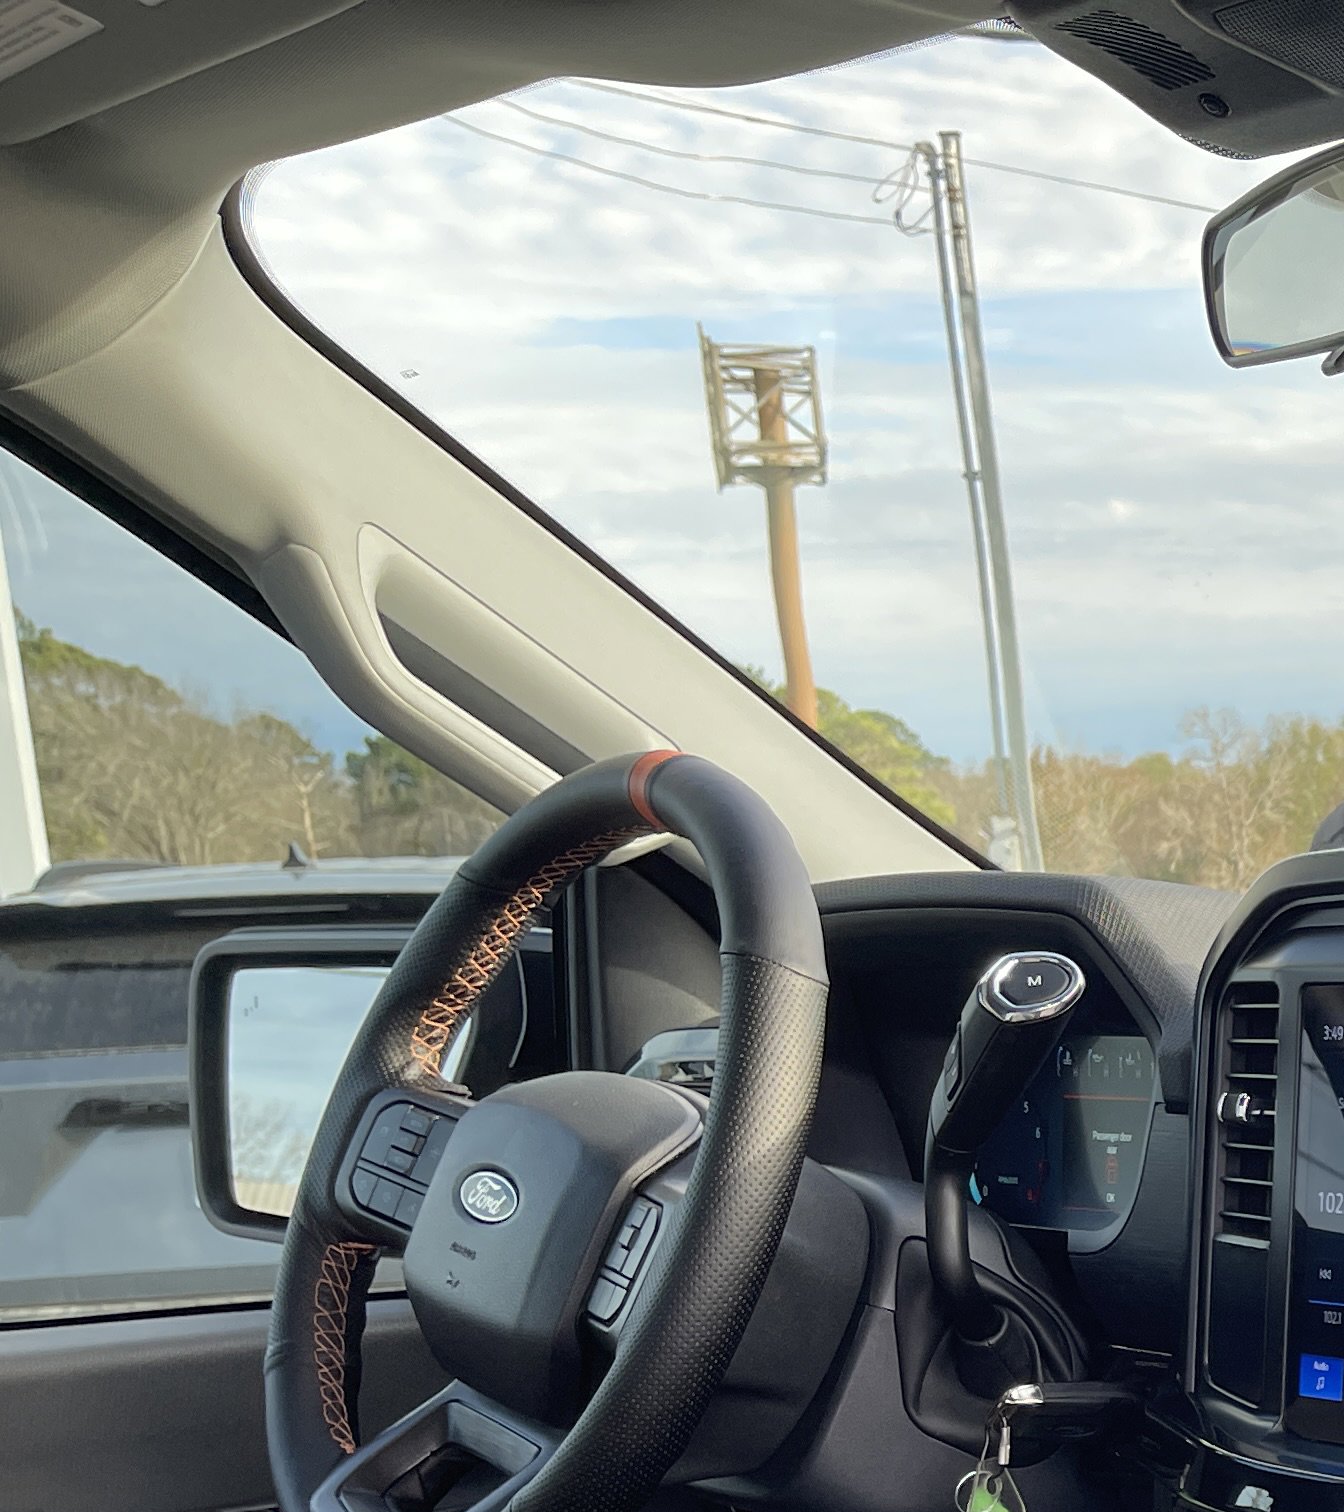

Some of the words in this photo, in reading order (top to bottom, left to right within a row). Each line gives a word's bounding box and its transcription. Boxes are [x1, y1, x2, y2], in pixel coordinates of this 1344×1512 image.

[1026, 975, 1043, 987] M
[1322, 1024, 1344, 1042] 3:49
[467, 1177, 508, 1215] Ford
